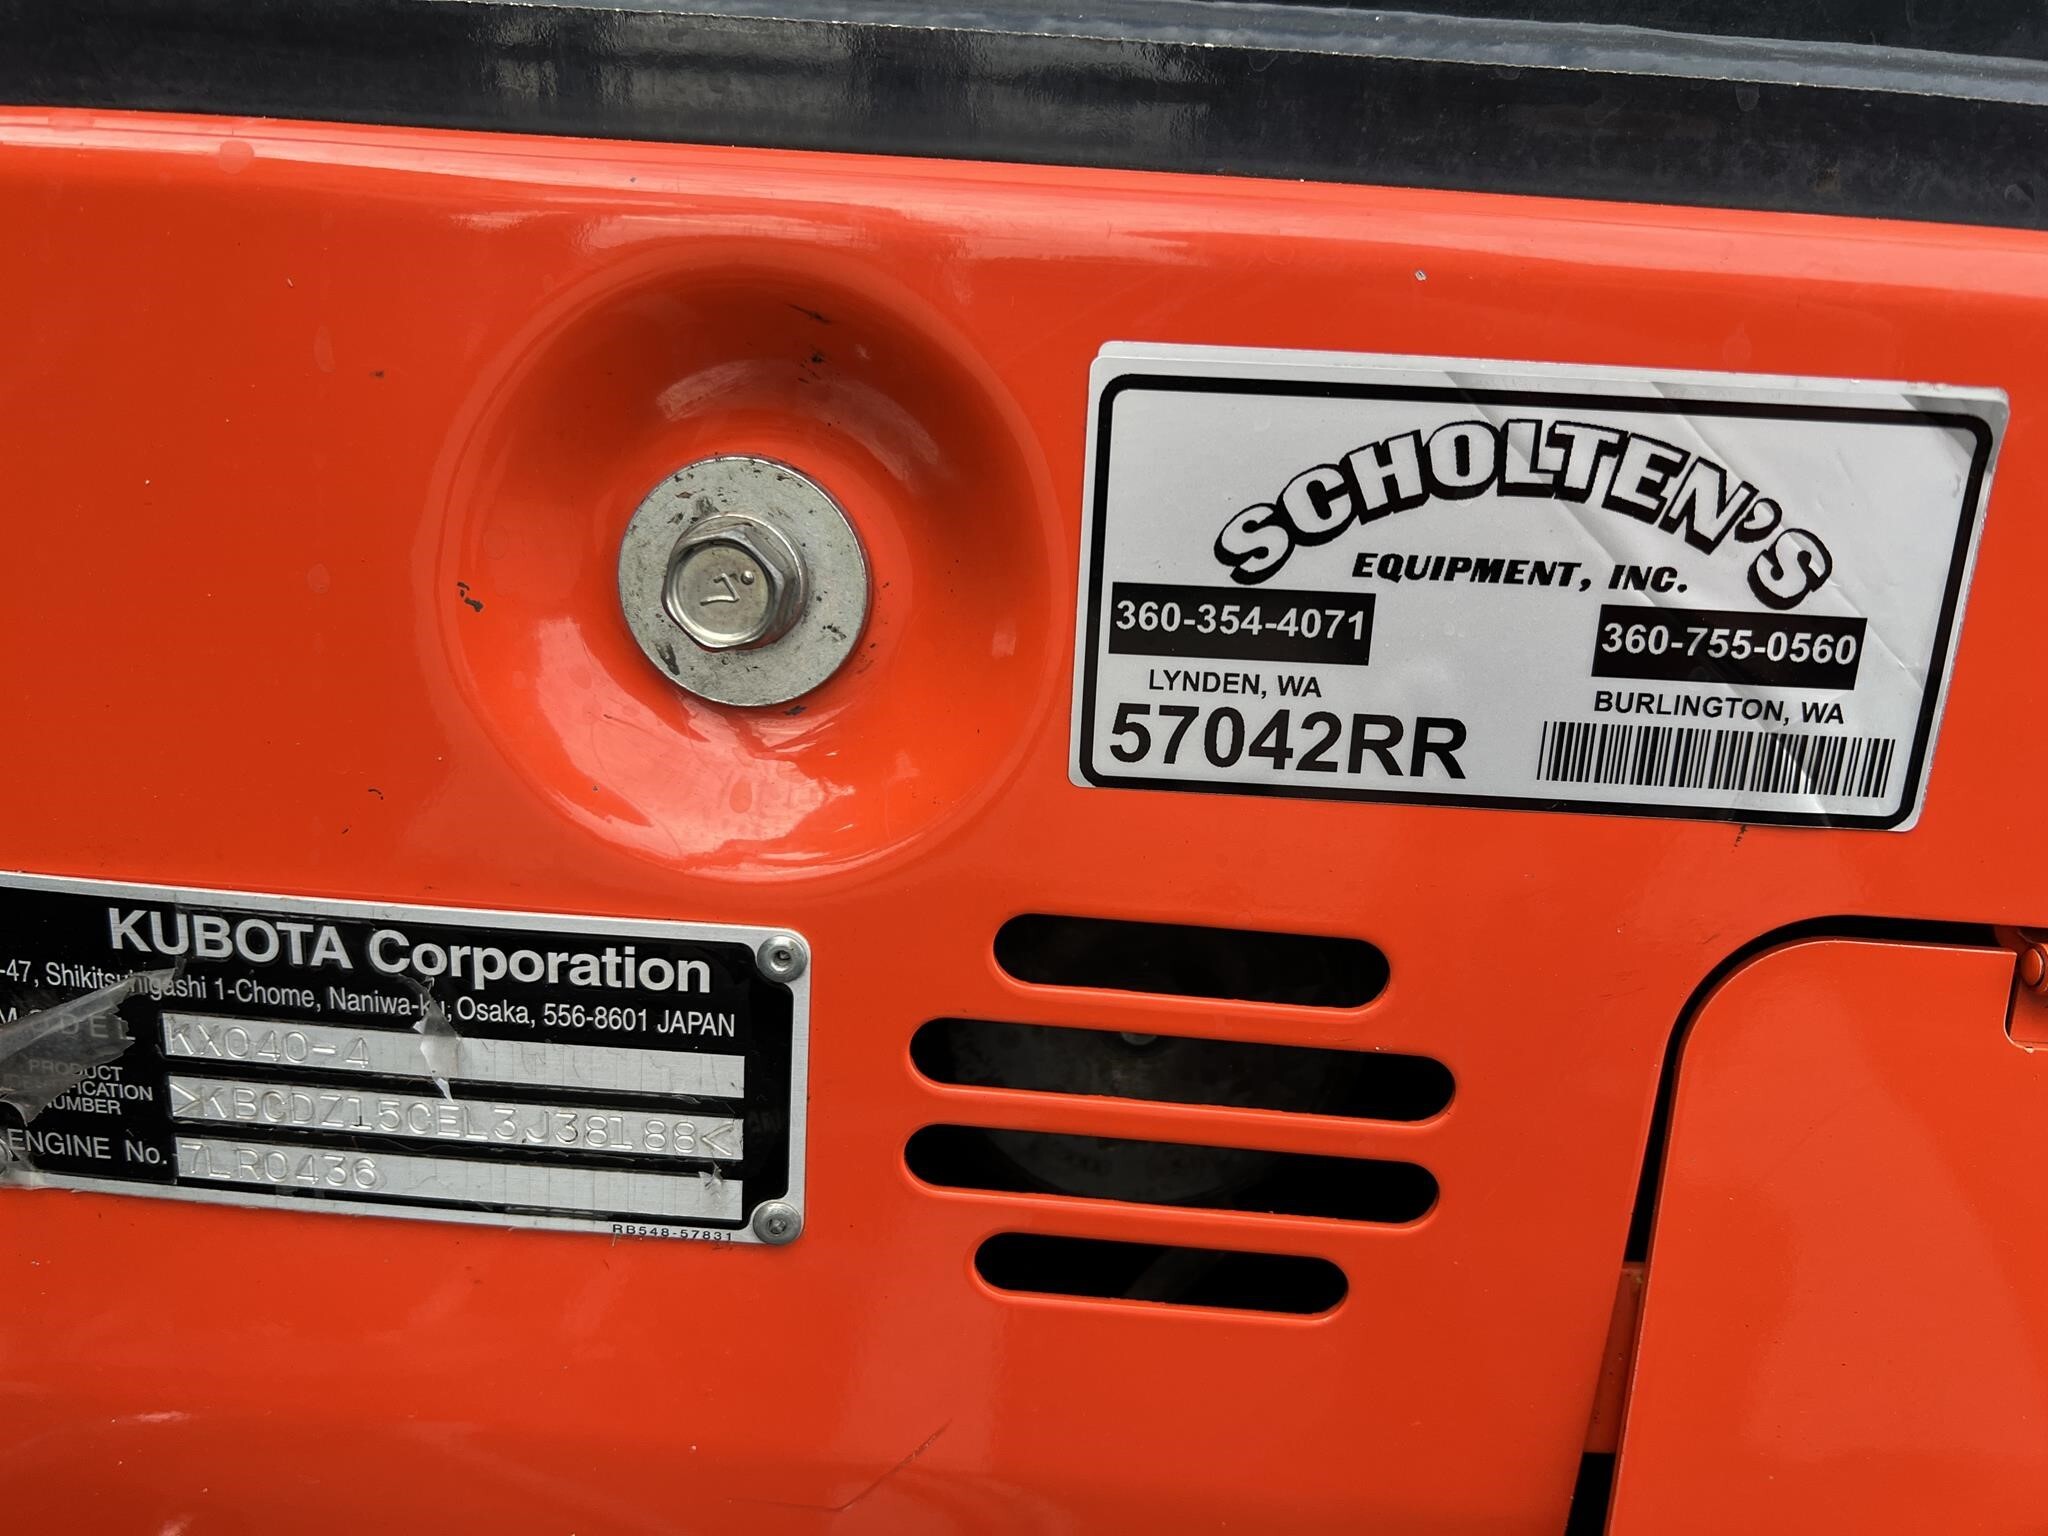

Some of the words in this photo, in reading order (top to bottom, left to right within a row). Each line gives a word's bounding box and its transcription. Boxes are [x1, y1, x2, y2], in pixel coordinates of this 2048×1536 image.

[1213, 418, 1833, 611] SCHOLTEN'S
[1352, 552, 1592, 592] EQUIPMENT,
[1608, 563, 1688, 594] INC.
[1115, 600, 1365, 641] 360-354-4071
[1601, 623, 1857, 665] 360-755-0560
[1149, 669, 1267, 699] LYNDEN,
[1277, 675, 1322, 698] WA
[1594, 690, 1790, 726] BURLINGTON,
[1801, 702, 1845, 725] WA
[1109, 702, 1468, 780] 57042RR
[108, 907, 354, 970] KUBOTA
[369, 929, 711, 994] Corporation
[214, 979, 321, 1013] 1-Chome,
[457, 996, 536, 1028] Osaka,
[543, 1003, 648, 1033] 556-8601
[657, 1010, 736, 1038] JAPAN
[7, 1128, 112, 1159] ENGINE
[124, 1139, 168, 1165] No.
[612, 1223, 732, 1242] RB548-57831
